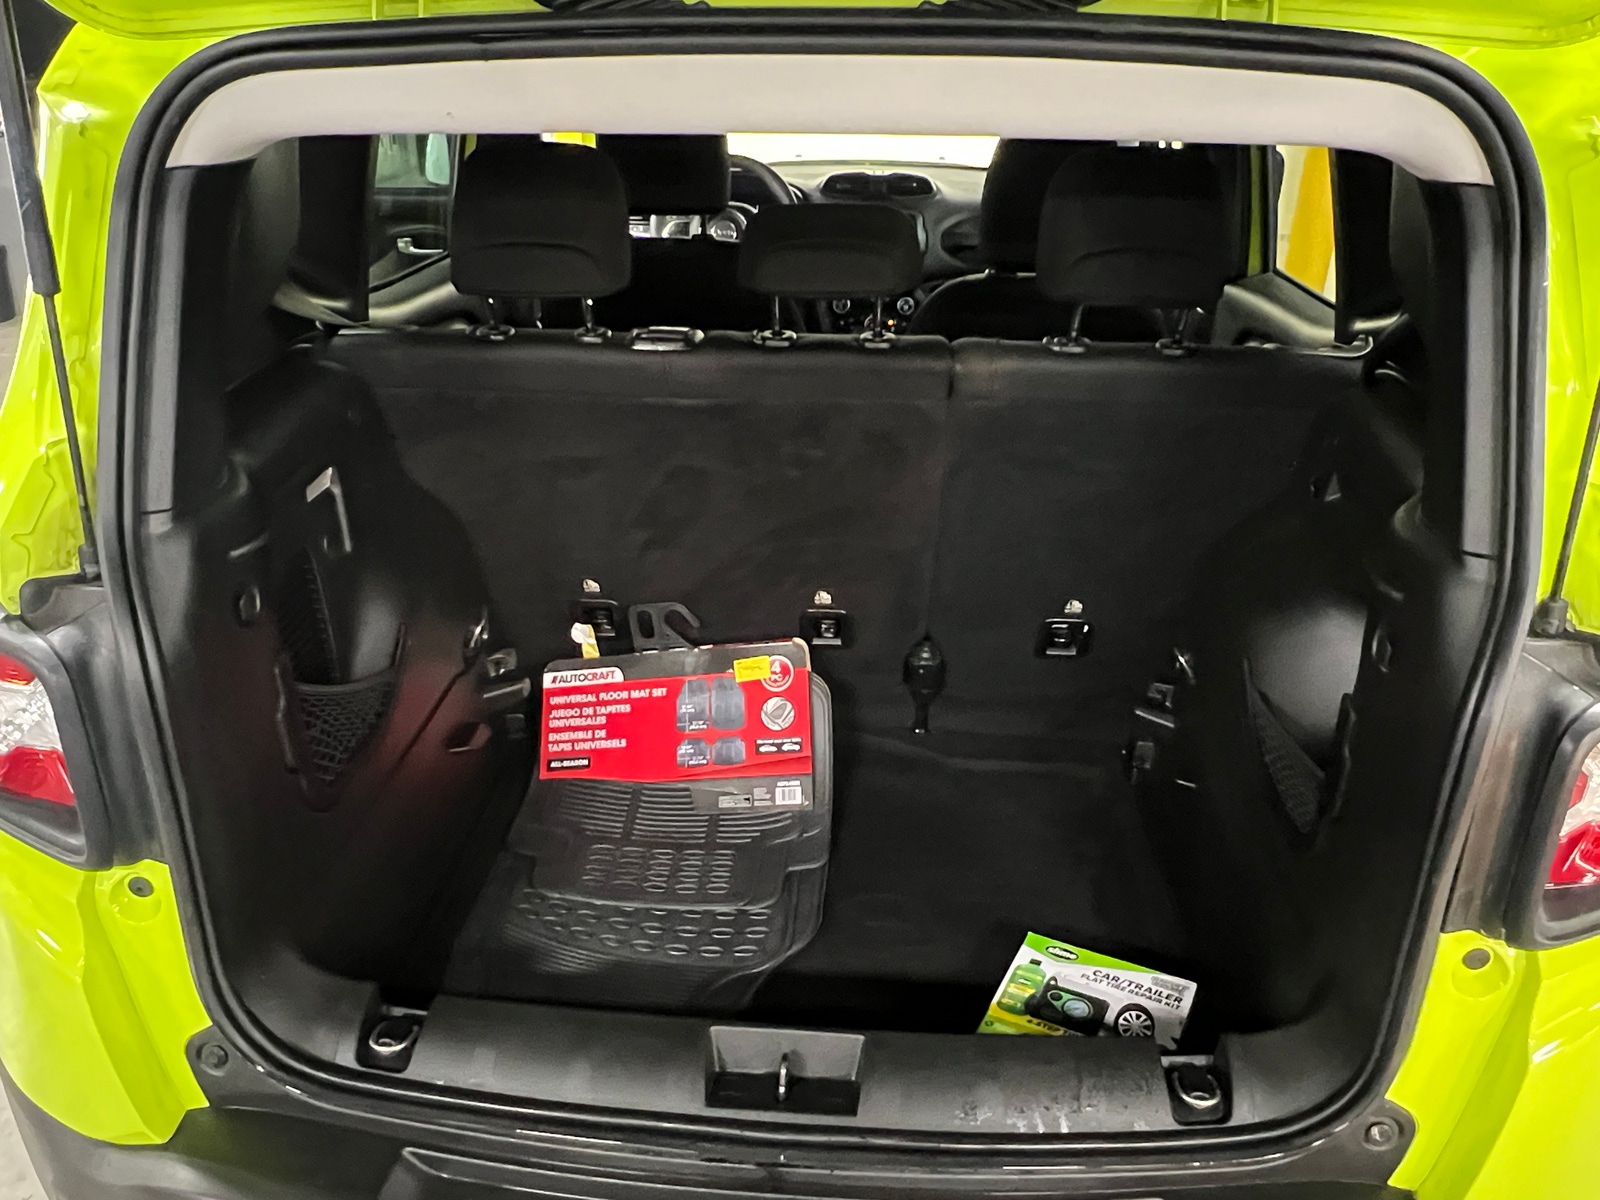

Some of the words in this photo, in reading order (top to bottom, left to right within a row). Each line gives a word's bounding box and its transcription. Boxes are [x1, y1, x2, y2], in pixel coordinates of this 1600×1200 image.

[770, 660, 782, 674] 4
[558, 670, 617, 684] AUTOCRAFT
[549, 694, 598, 705] UNIVERSAL
[599, 691, 629, 702] FLOOR
[630, 688, 650, 699] MAT
[652, 687, 668, 697] SET
[549, 707, 580, 718] JUEGO
[582, 705, 594, 716] DE
[595, 704, 631, 715] TAPETES
[548, 715, 607, 728] UNIVERSALES
[548, 729, 593, 742] ENSEMBLE
[594, 729, 607, 739] DE
[547, 742, 573, 752] TAPIS
[574, 738, 627, 751] UNIVERSELS
[1080, 973, 1105, 985] FLAT
[1105, 980, 1127, 992] TIRE
[1127, 988, 1162, 1004] REPAIR
[1163, 1001, 1182, 1011] KIT
[1093, 970, 1183, 1004] CAR/TRAILER
